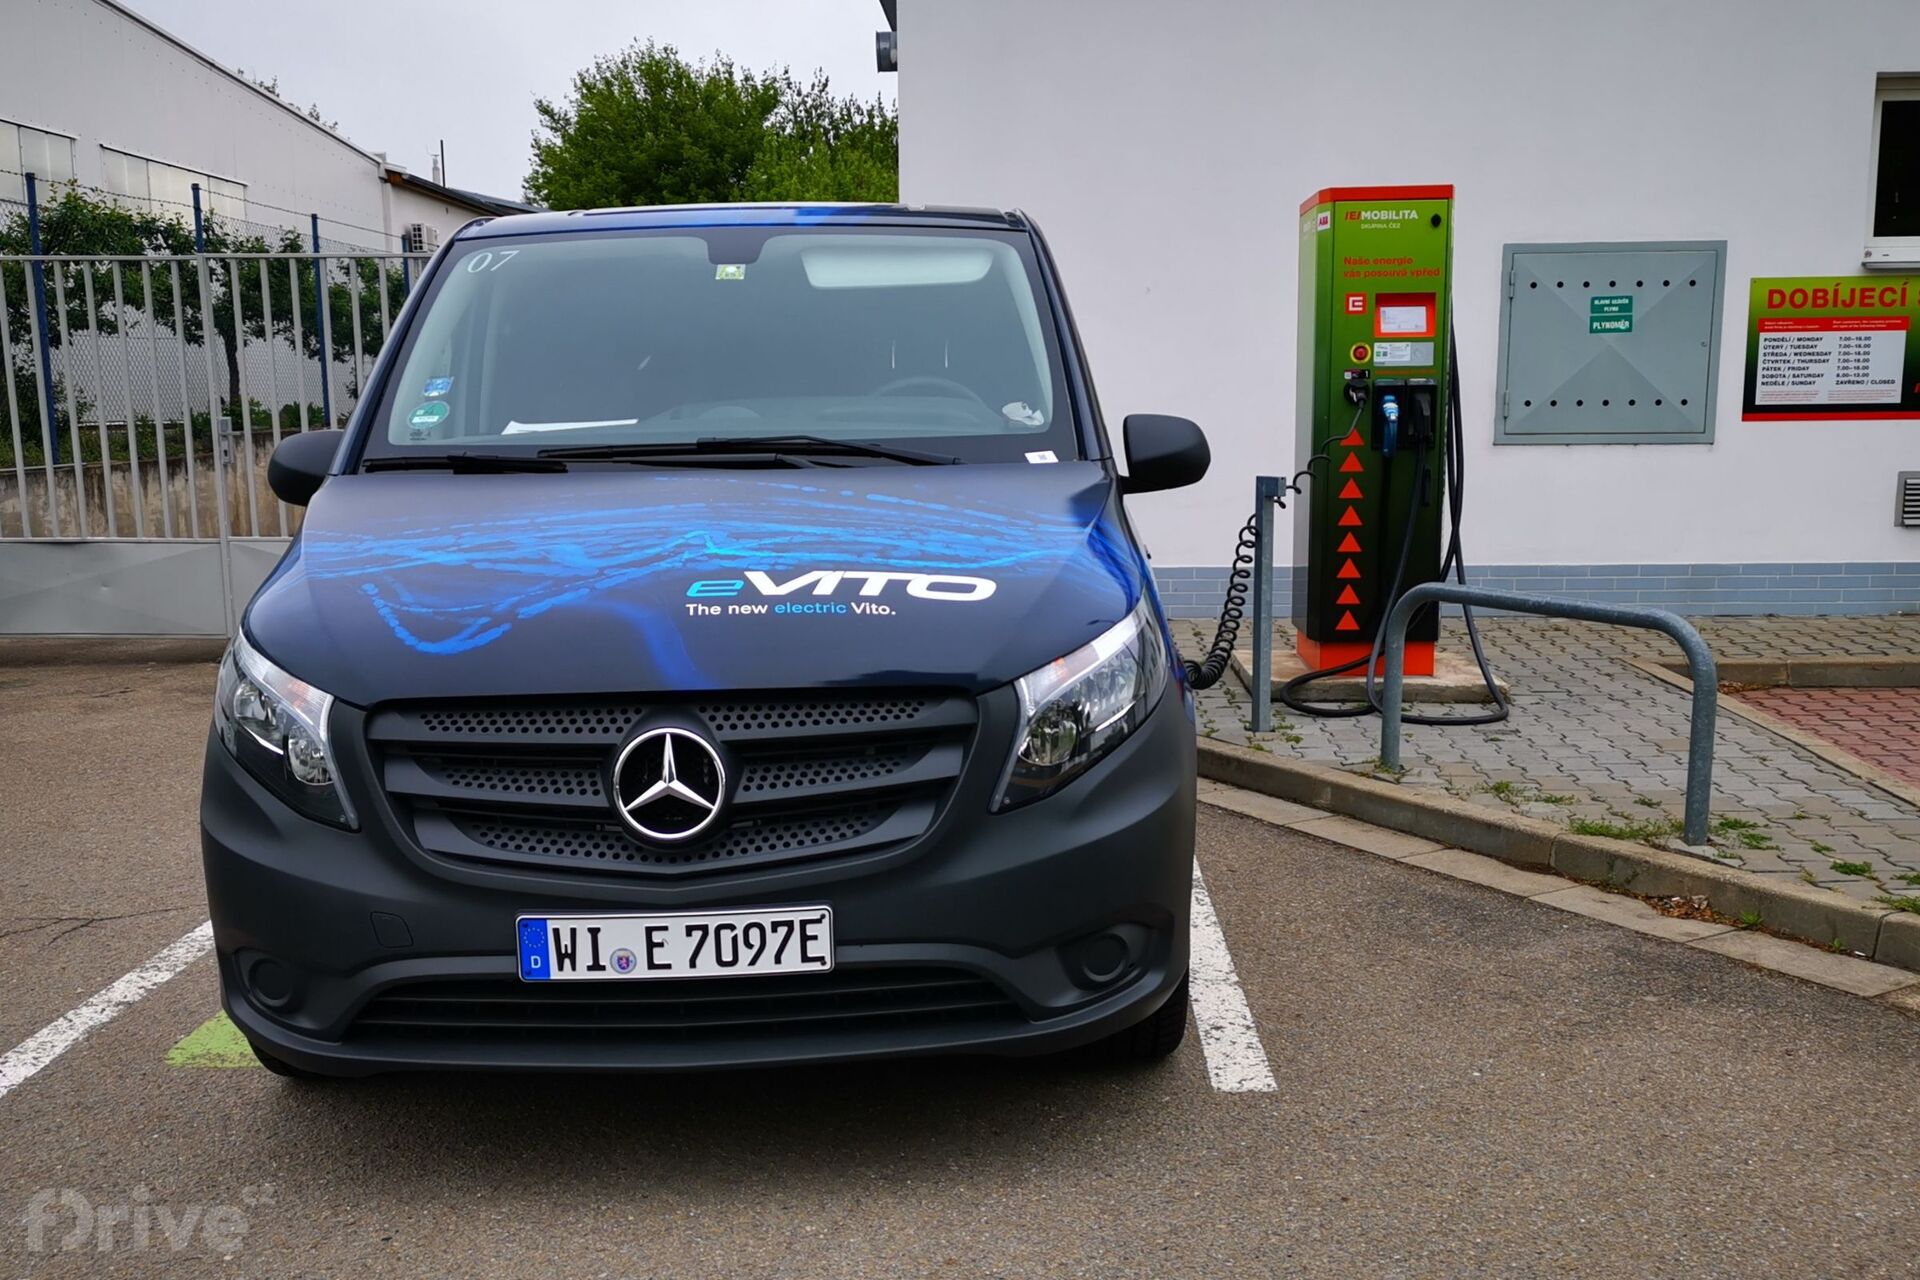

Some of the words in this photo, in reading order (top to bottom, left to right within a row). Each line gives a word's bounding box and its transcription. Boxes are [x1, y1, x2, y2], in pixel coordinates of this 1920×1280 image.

[468, 250, 520, 272] 07
[1767, 279, 1910, 309] DOBÍJECÍ
[686, 603, 721, 616] The
[728, 604, 768, 615] new
[774, 601, 847, 615] electric
[850, 602, 896, 616] Vito.
[552, 926, 606, 972] WI
[530, 956, 541, 968] D
